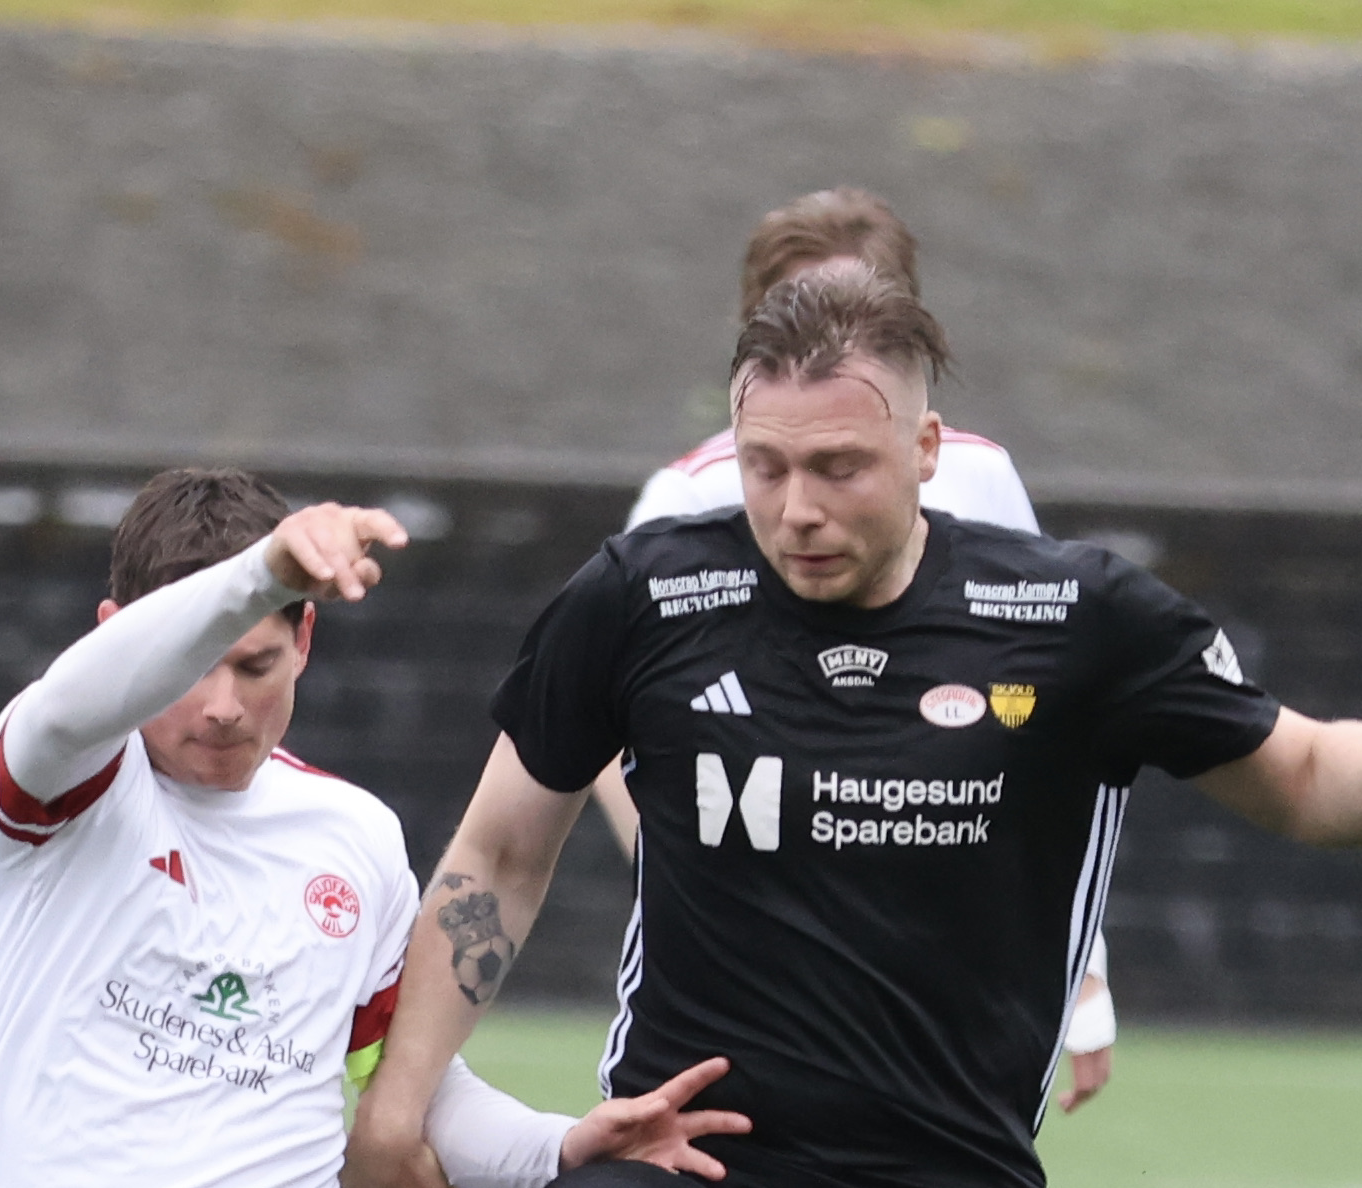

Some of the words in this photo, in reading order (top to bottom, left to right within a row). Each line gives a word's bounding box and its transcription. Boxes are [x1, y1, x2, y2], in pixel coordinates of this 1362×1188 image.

[660, 586, 751, 618] RECYCLING
[970, 601, 1067, 622] RECYCLING
[827, 650, 881, 670] MENY
[813, 771, 1005, 812] Haugesund
[812, 812, 989, 850] Sparebank
[99, 979, 227, 1049] Skudenes
[226, 1026, 249, 1056] &
[254, 1034, 317, 1075] Aakra
[133, 1030, 276, 1094] Sparebank
